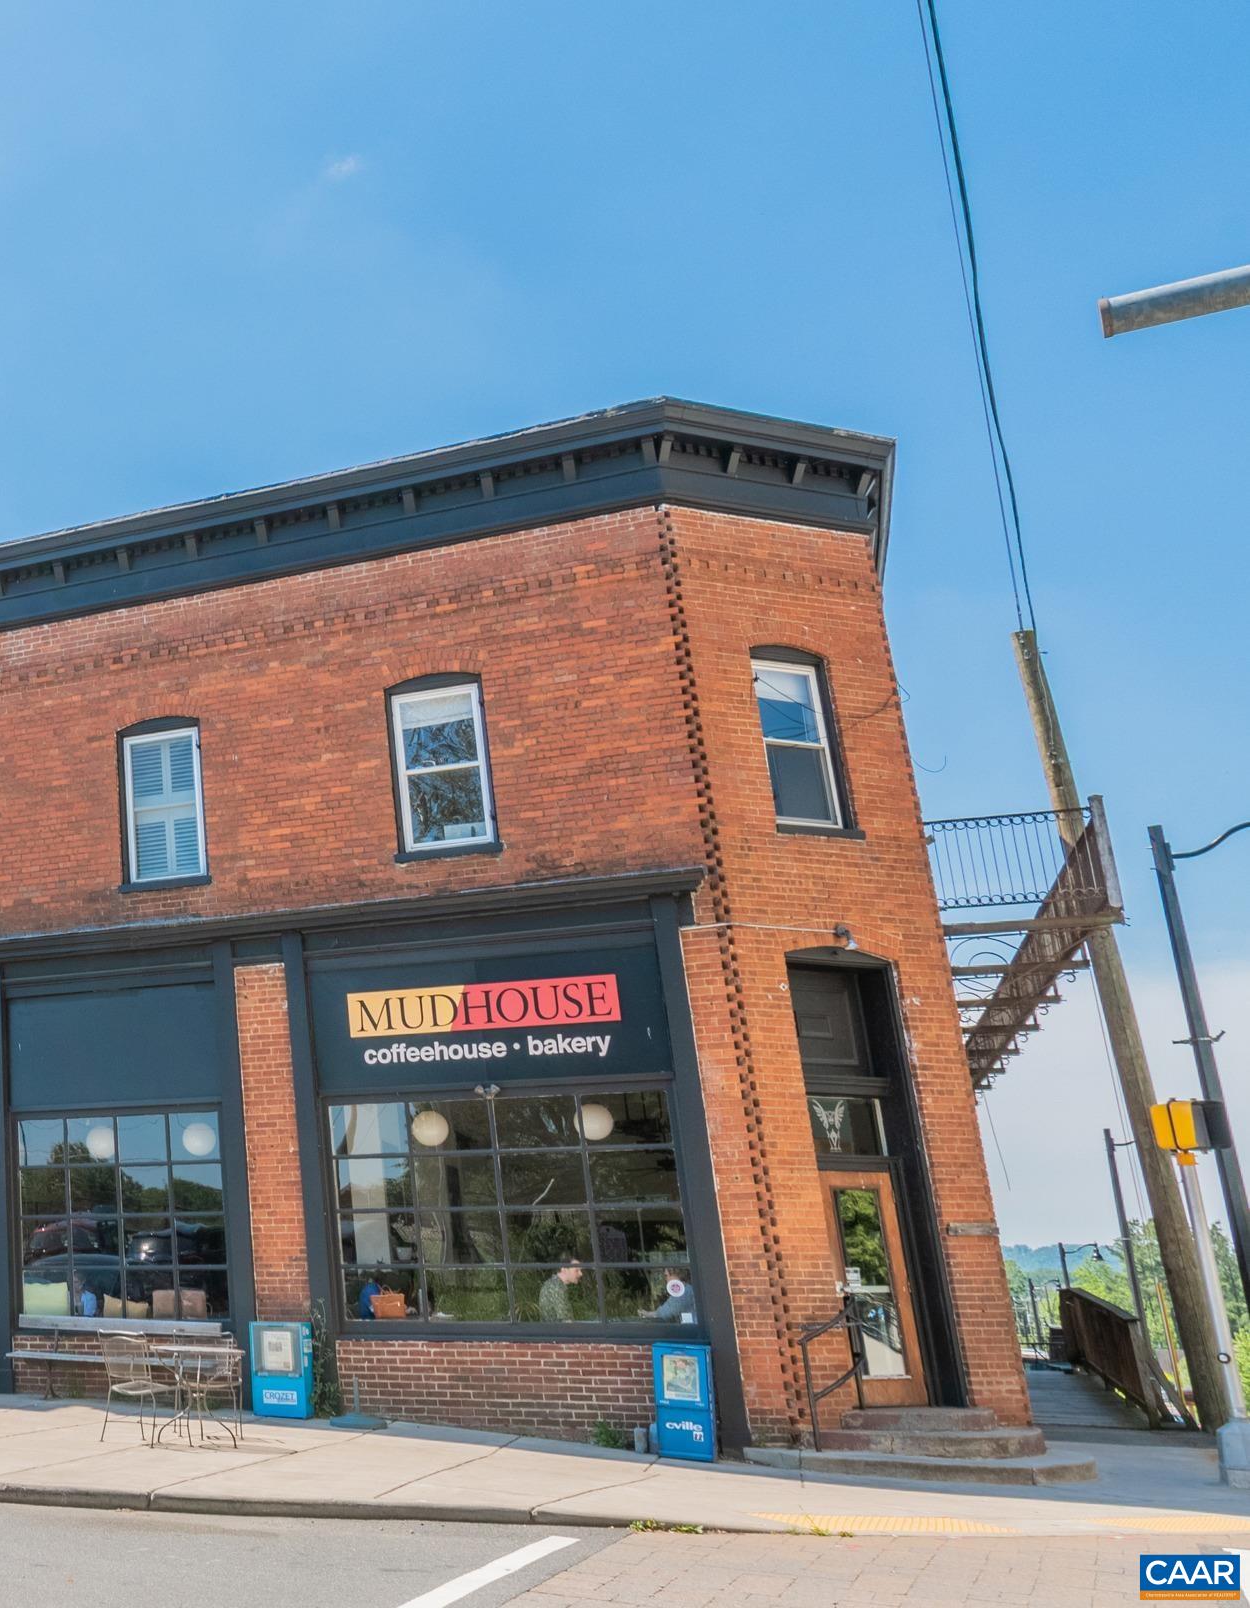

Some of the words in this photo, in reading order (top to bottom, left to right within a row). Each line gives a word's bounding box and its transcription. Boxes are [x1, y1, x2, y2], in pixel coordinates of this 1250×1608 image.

[357, 981, 613, 1033] MUDHOUSE
[364, 1040, 508, 1065] coffeehouse
[527, 1033, 611, 1057] bakery
[264, 1391, 295, 1401] CROZET
[665, 1421, 703, 1432] cville
